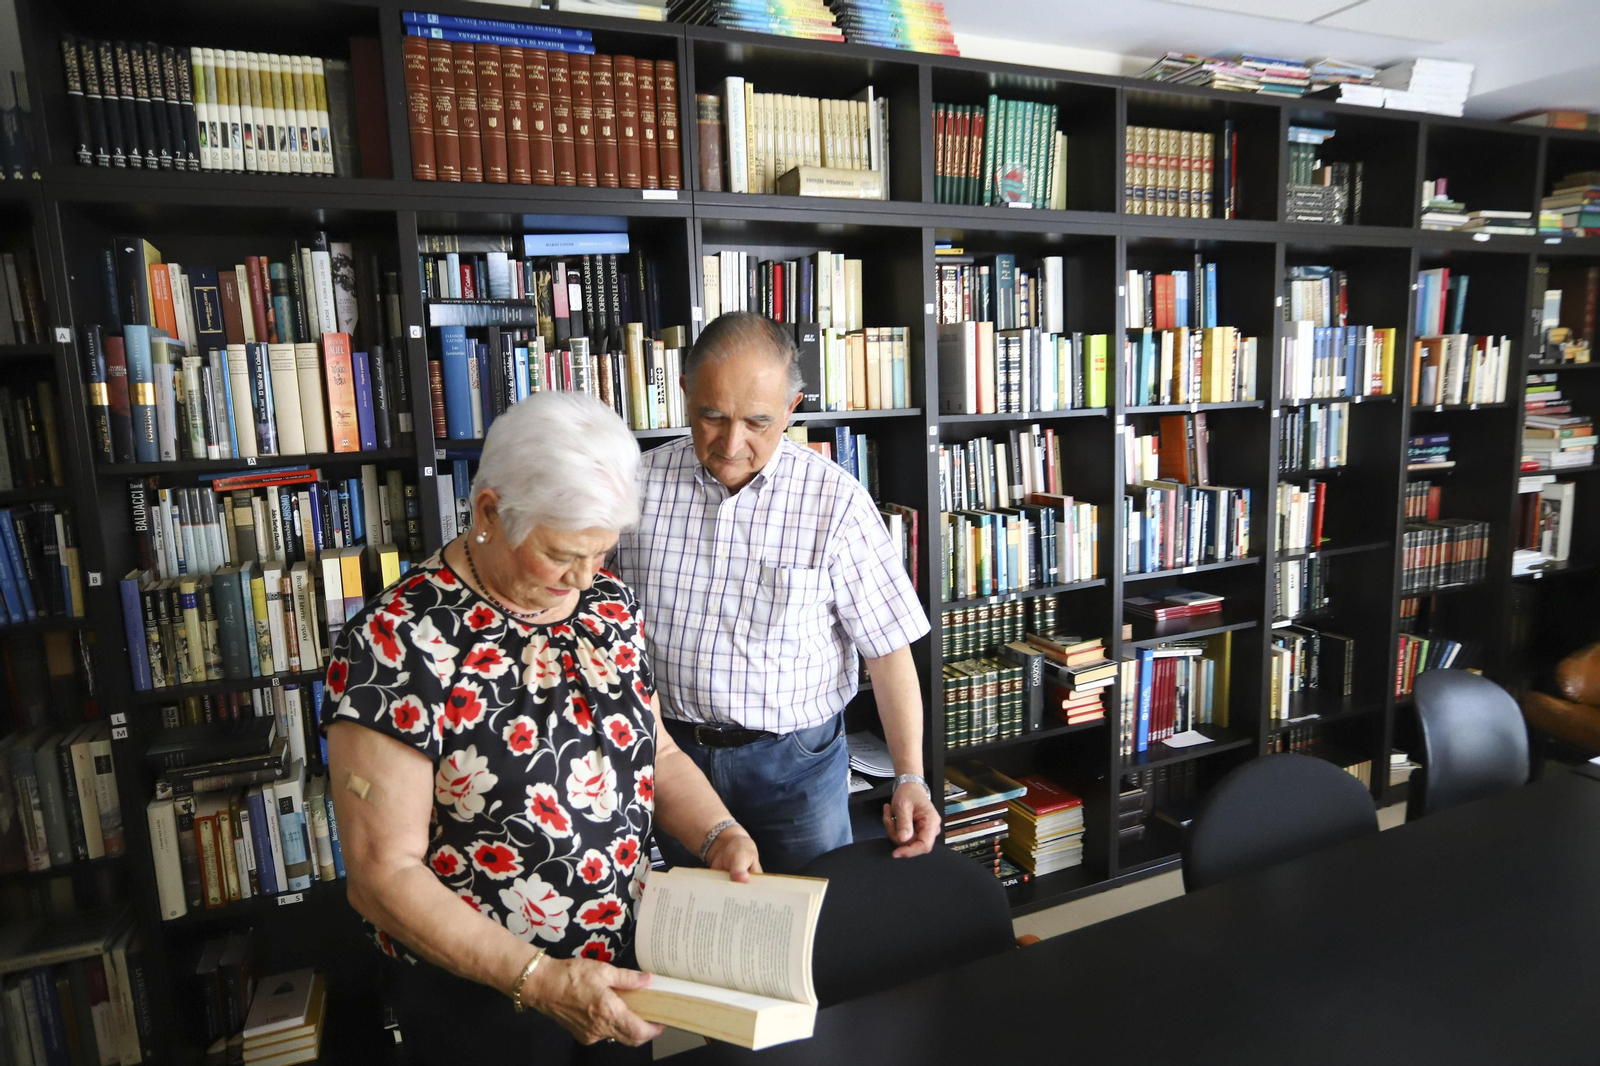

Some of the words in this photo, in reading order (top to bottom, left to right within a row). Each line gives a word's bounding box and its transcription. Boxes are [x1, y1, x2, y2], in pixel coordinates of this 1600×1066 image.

[81, 144, 86, 152] 2
[162, 148, 167, 156] 6
[189, 152, 194, 160] 8
[204, 152, 208, 160] 1
[212, 152, 219, 160] 2
[223, 152, 230, 160] 3
[582, 261, 591, 284] CARRÉ
[610, 260, 618, 283] CARRÉ
[586, 294, 594, 312] JOHN
[598, 294, 606, 312] JOHN
[612, 294, 620, 312] JOHN
[656, 367, 664, 404] BANCO
[144, 408, 154, 443] FORTUNA
[131, 490, 147, 532] BALDACCI
[281, 494, 292, 520] ABISMO
[304, 518, 314, 556] SUBURBIO
[1033, 657, 1041, 686] GARZÓN
[330, 824, 338, 841] Mercedes
